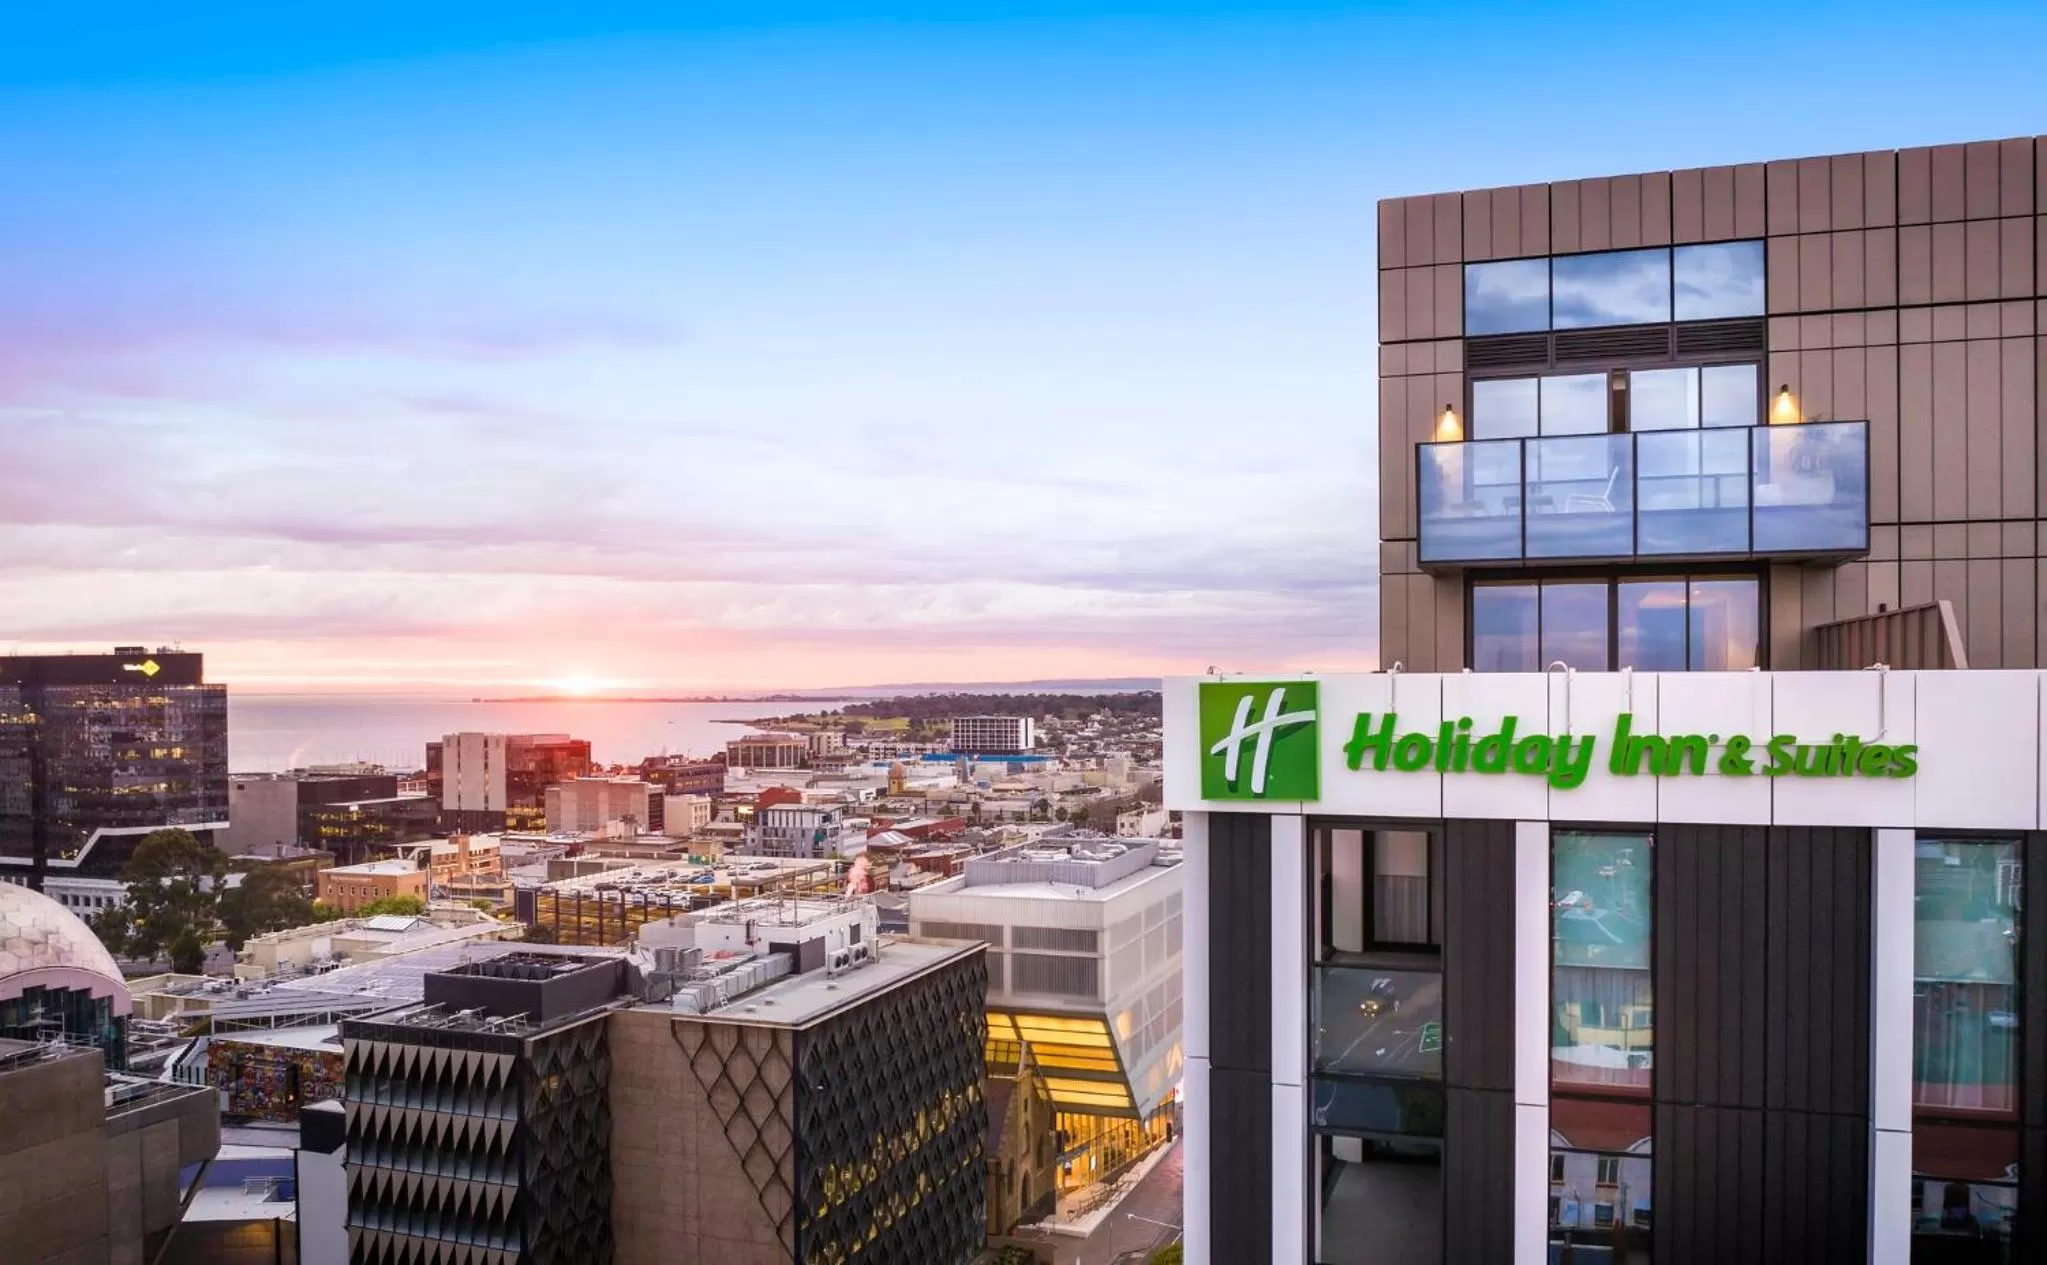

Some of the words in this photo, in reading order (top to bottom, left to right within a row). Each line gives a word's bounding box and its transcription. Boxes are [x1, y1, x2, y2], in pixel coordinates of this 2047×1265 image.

[1343, 712, 1597, 790] Holiday
[1608, 713, 1709, 777] Inn
[1718, 735, 1755, 777] &
[1762, 732, 1918, 778] Suites
